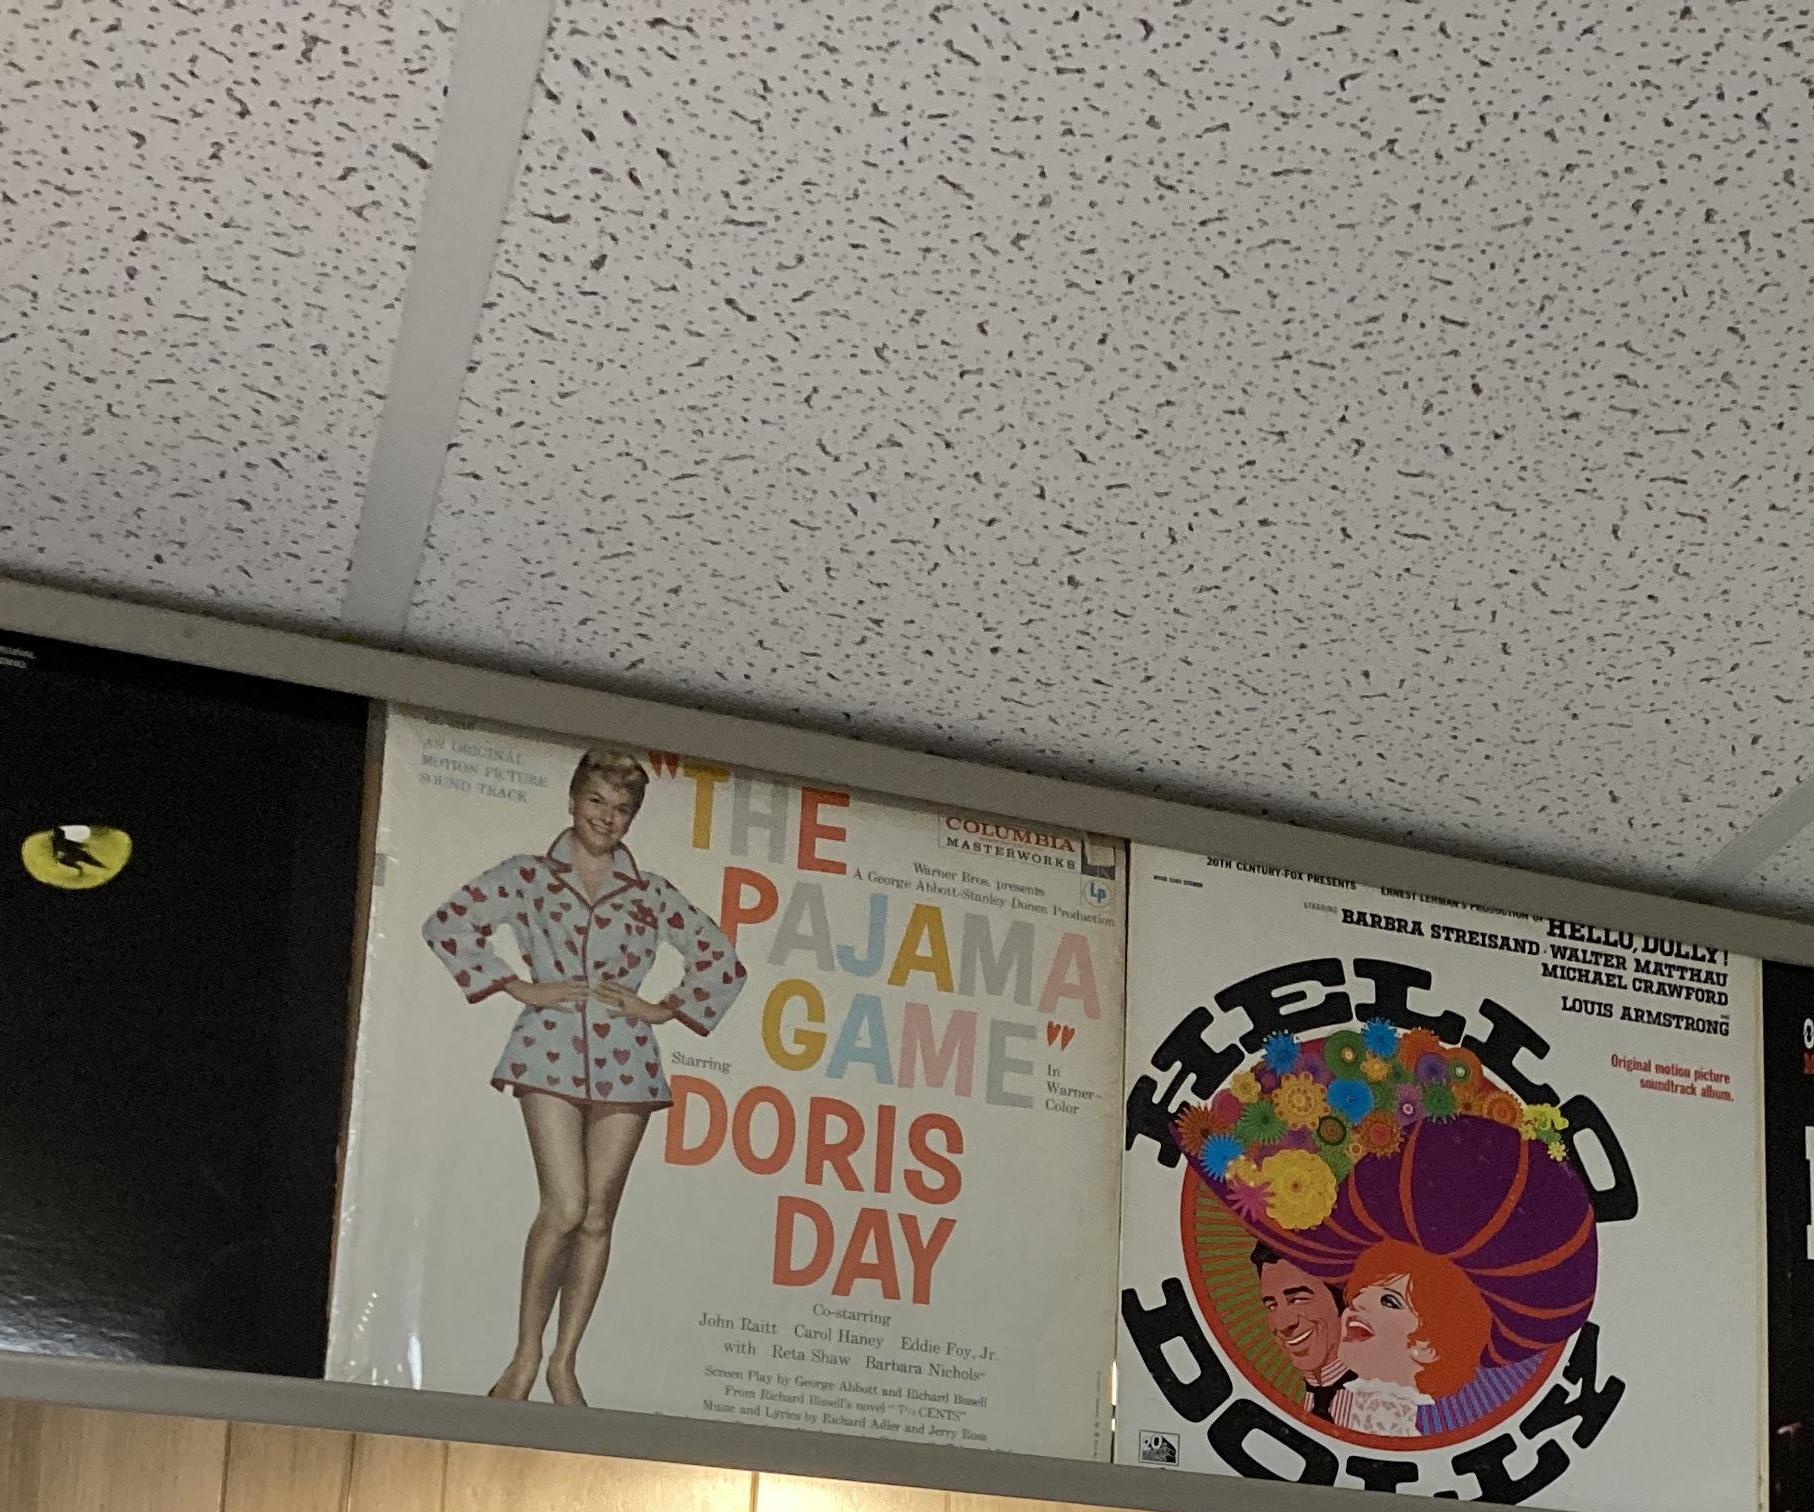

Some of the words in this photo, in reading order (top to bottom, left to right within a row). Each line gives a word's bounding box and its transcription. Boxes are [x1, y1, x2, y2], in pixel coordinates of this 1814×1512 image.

[945, 816, 1076, 853] COLUMBIA
[946, 837, 1077, 871] MASTERWORKS
[913, 862, 958, 882] Warner
[996, 881, 1045, 897] presents
[1206, 856, 1234, 870] 20TH
[1307, 873, 1356, 890] PRESENTS
[853, 868, 863, 880] A
[867, 870, 911, 890] George
[1053, 906, 1116, 927] Production
[720, 866, 1101, 1019] PAJAMA
[1341, 908, 1425, 937] BARBRA
[1430, 924, 1541, 956] STREISAND
[1550, 944, 1628, 971] WALTER
[1634, 958, 1729, 987] MATTHAU
[1541, 963, 1628, 991] MICHAEL
[1632, 978, 1729, 1007] CRAWFORD
[1561, 996, 1613, 1018] LOUIS
[1620, 1006, 1730, 1037] ARMSTRONG
[672, 1051, 731, 1074] Starring
[1046, 1064, 1060, 1078] In
[1610, 1053, 1651, 1074] Original
[1655, 1063, 1691, 1079] motion
[1694, 1066, 1730, 1084] picture
[1046, 1082, 1095, 1100] Warner
[1639, 1076, 1697, 1097] soundtrack
[1045, 1098, 1080, 1115] Color
[664, 1074, 964, 1205] DORIS
[772, 1195, 957, 1305] DAY
[812, 1303, 892, 1327] Co-starring
[698, 1312, 735, 1330] John
[741, 1317, 777, 1335] Raitt
[794, 1324, 832, 1342] Carol
[838, 1329, 884, 1349] Haney
[901, 1336, 941, 1355] Eddie
[723, 1341, 757, 1357] with
[771, 1344, 806, 1362] Reta
[811, 1349, 851, 1366] Shaw
[865, 1355, 923, 1375] Barbara
[928, 1363, 982, 1382] Nichols
